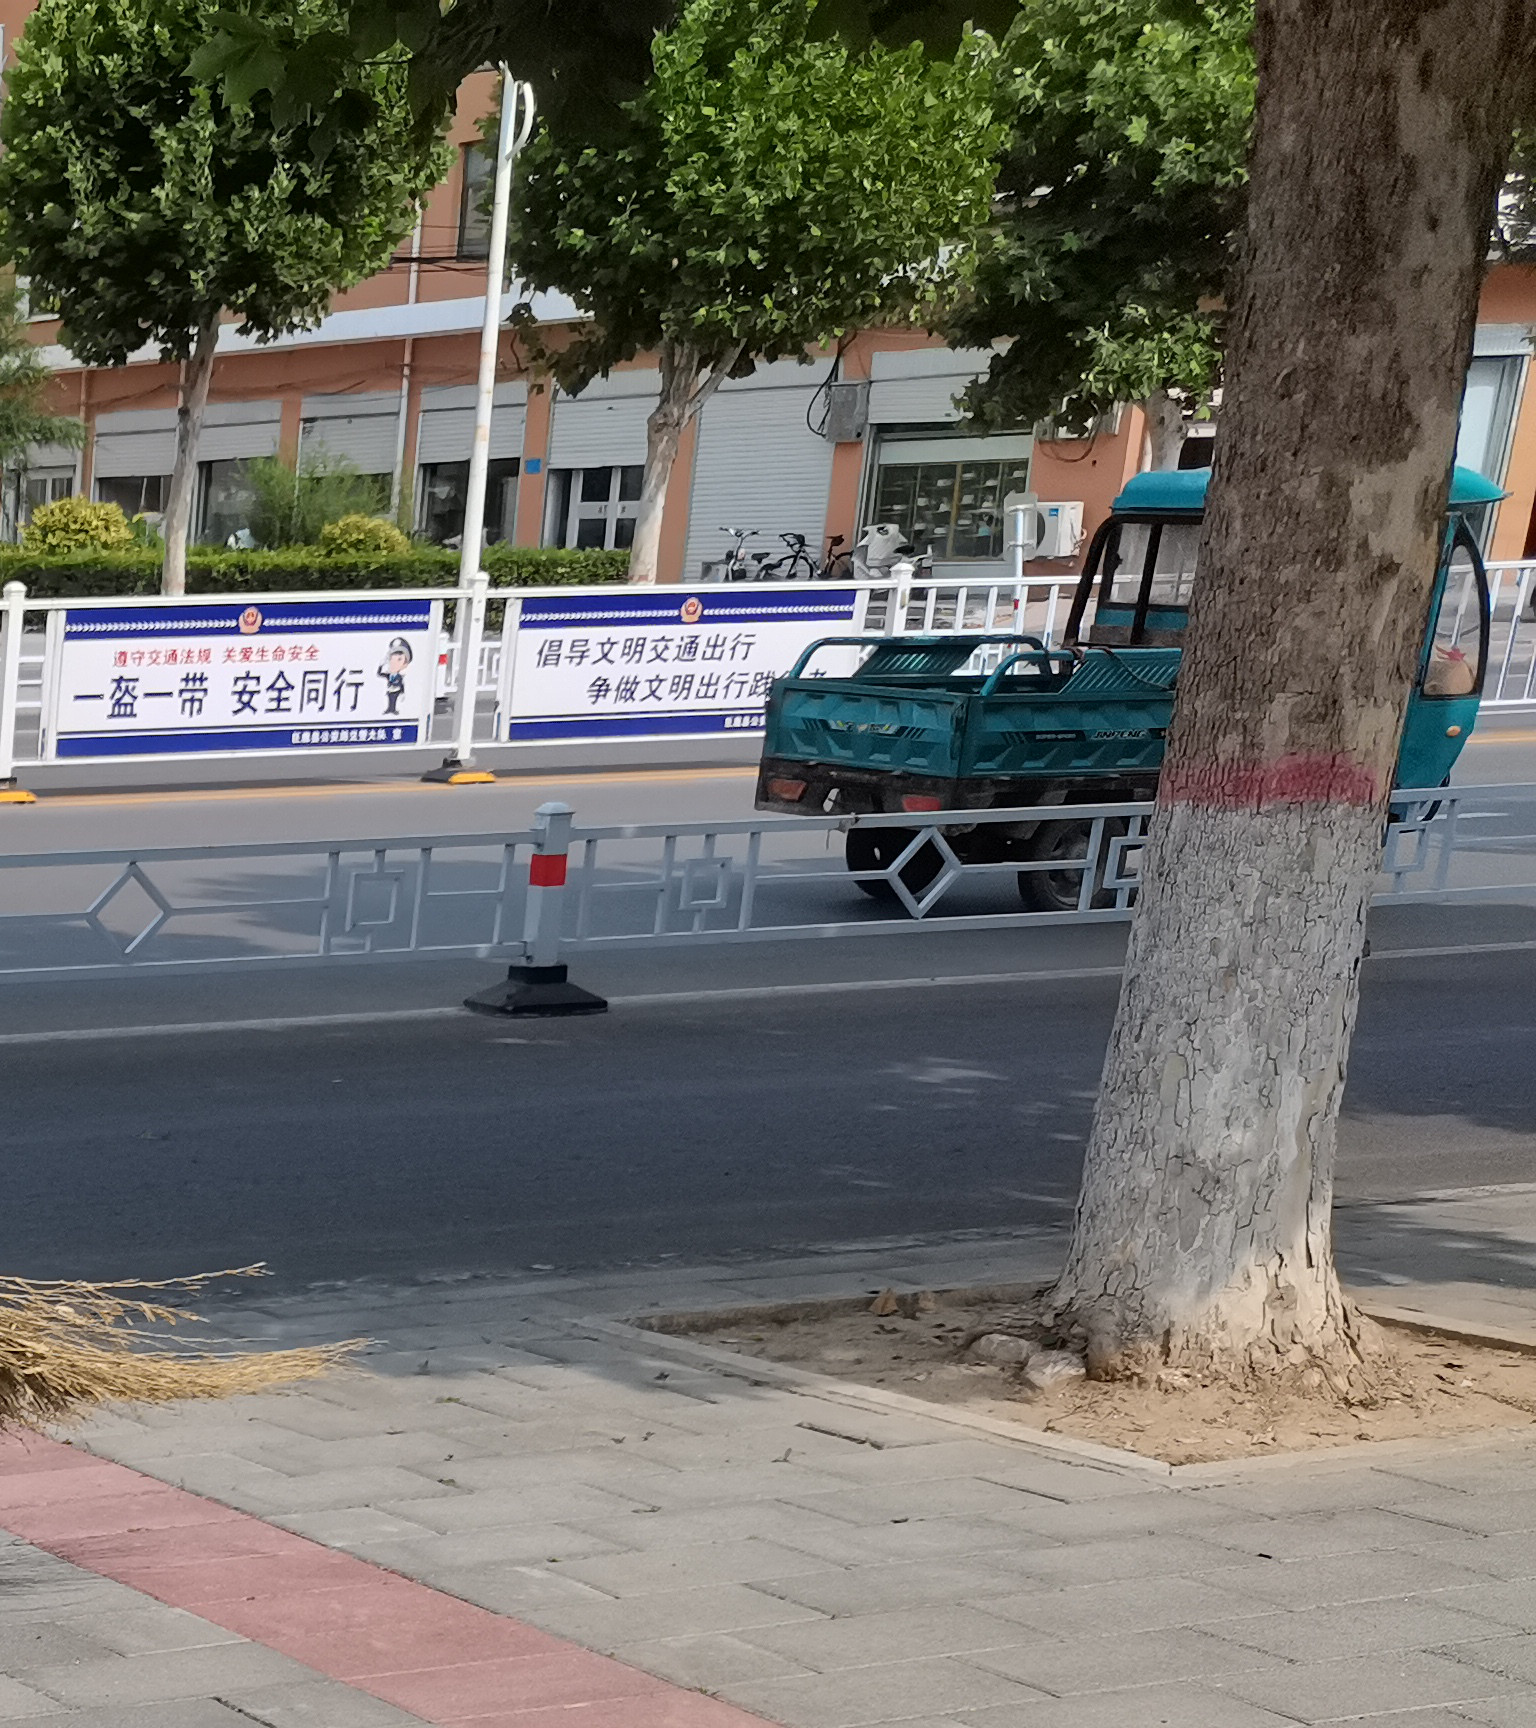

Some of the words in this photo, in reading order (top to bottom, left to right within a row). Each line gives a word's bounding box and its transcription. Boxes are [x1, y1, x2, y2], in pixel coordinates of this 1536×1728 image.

[112, 648, 213, 668] 遵守交通法规
[222, 643, 320, 665] 关爱生命安全
[536, 632, 757, 668] 倡导文明交通出行
[73, 671, 209, 719] 一盔一带
[231, 667, 365, 717] 安全同行
[586, 665, 826, 706] 争做文明出行践
